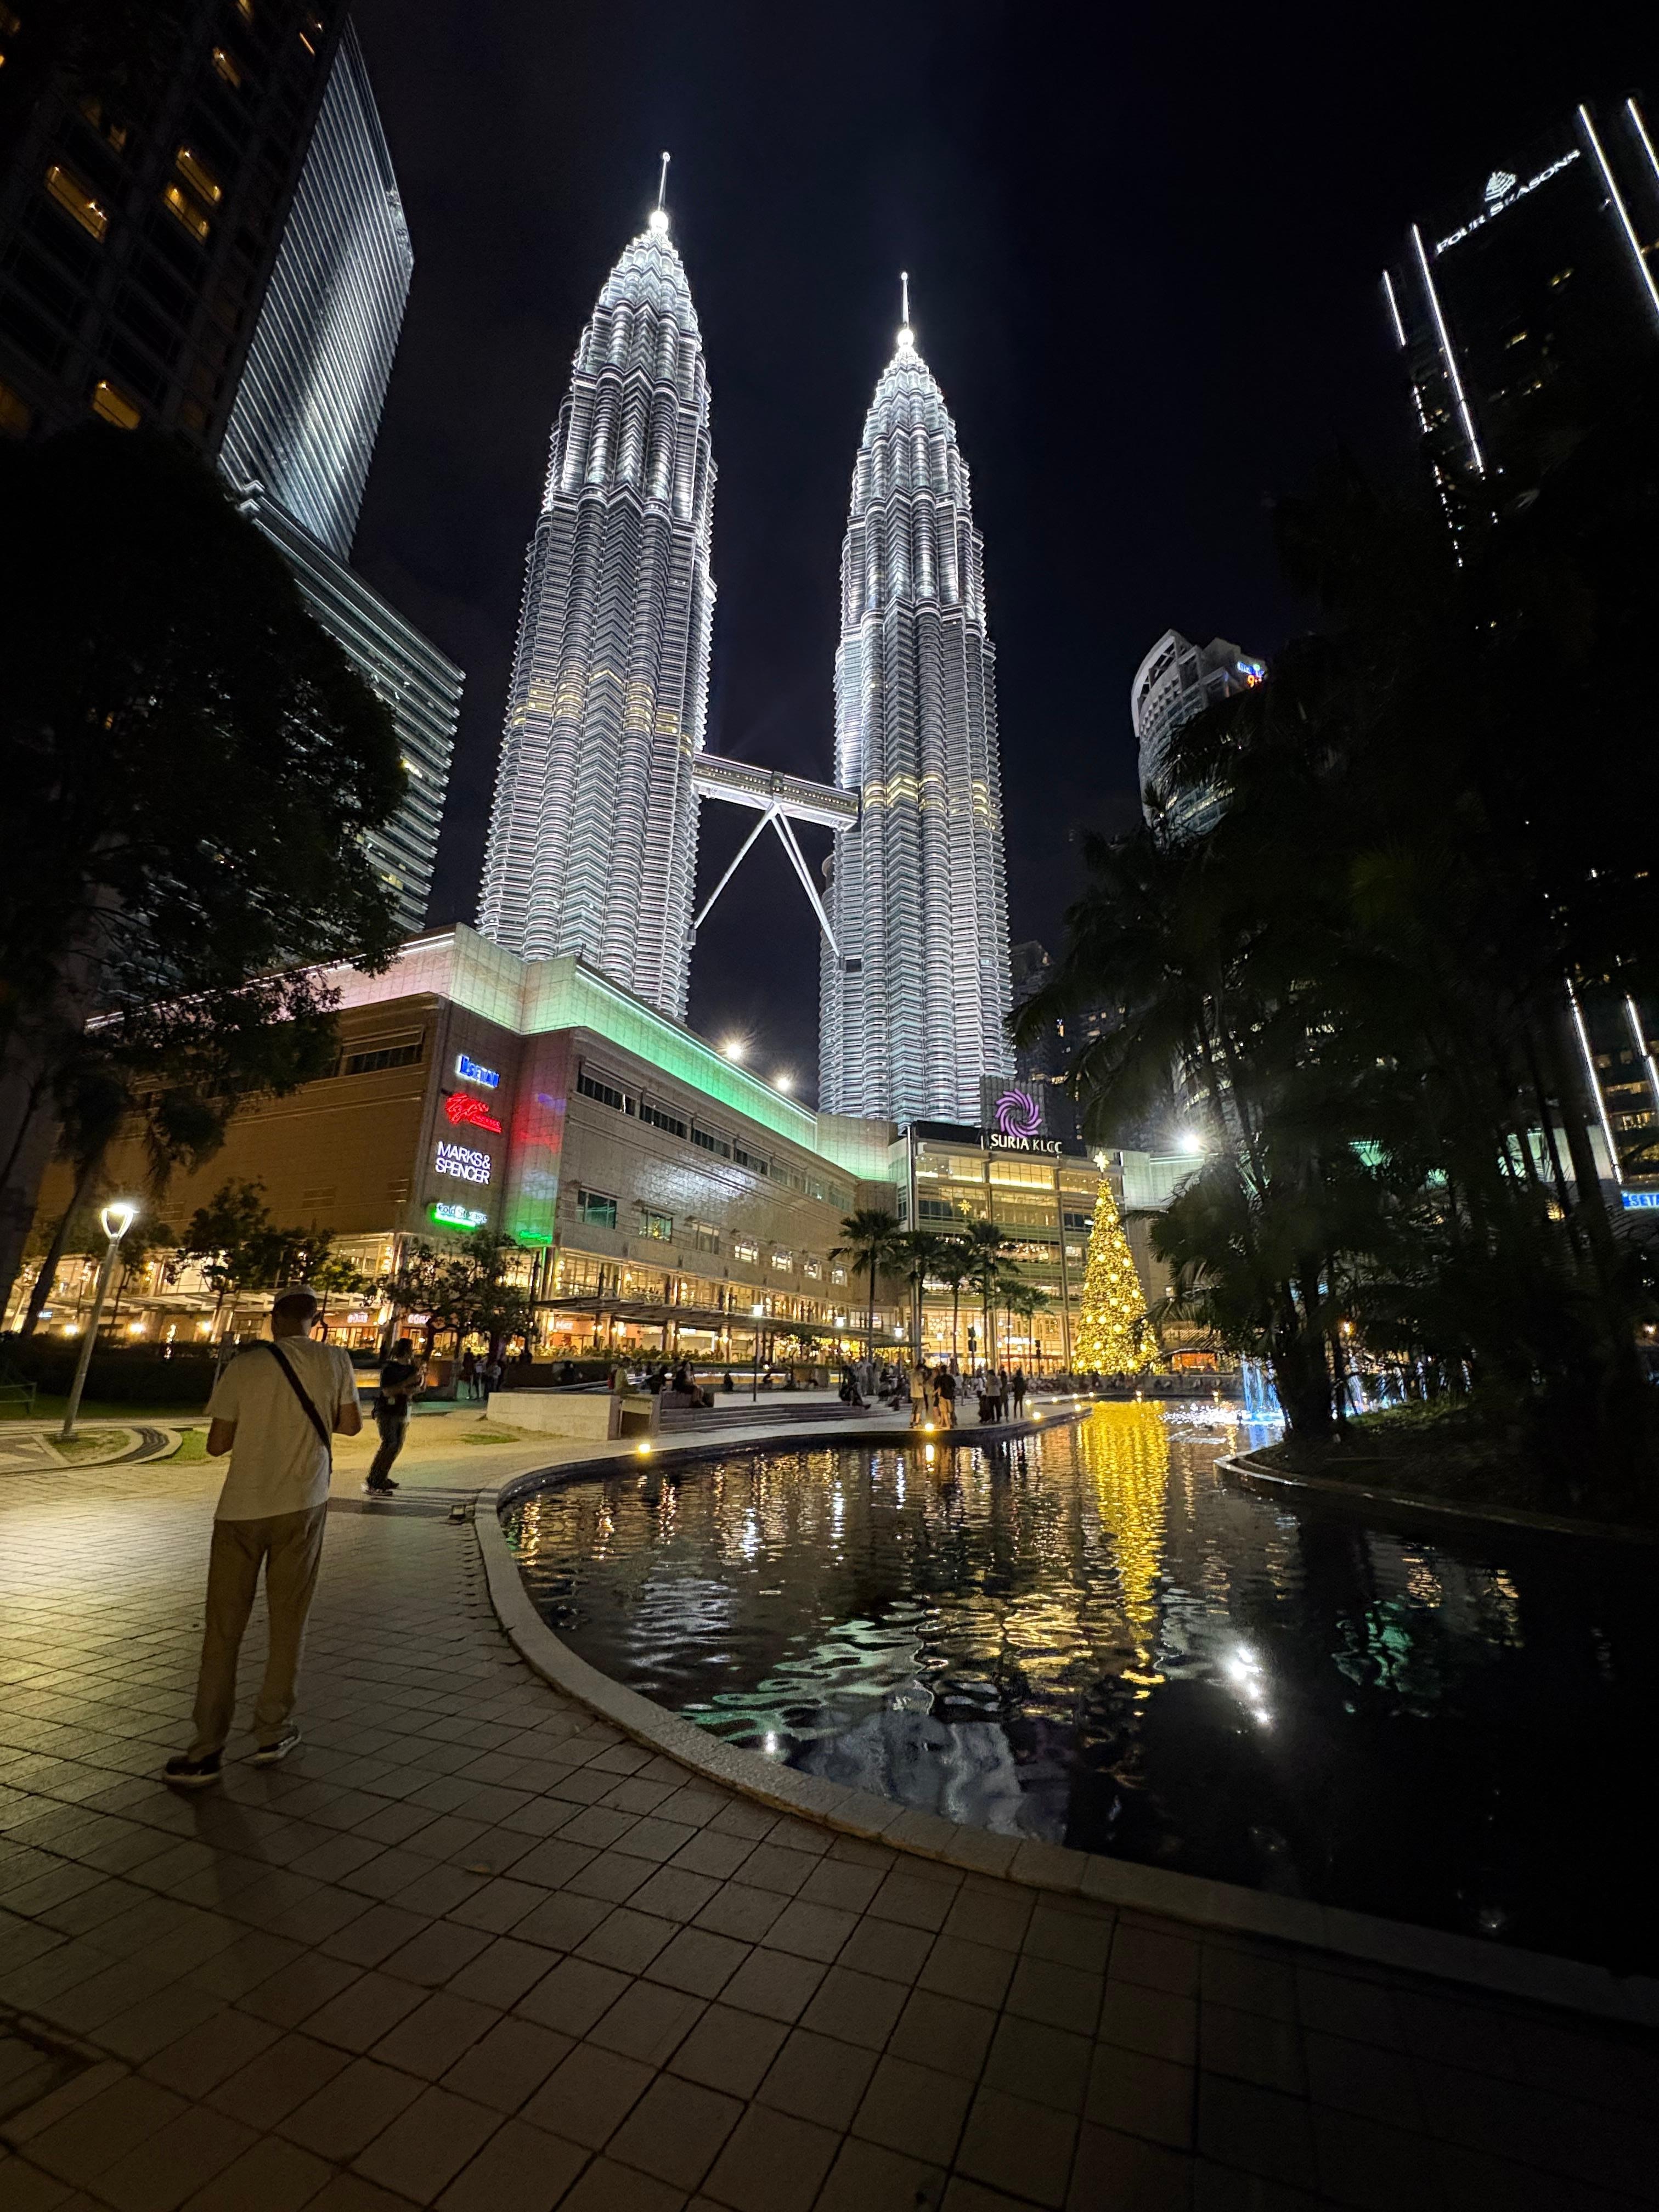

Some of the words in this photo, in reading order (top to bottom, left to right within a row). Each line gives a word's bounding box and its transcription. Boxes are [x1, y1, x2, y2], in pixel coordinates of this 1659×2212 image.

[1436, 215, 1486, 253] FOUR
[990, 1133, 1029, 1150] SURIA
[1033, 1139, 1062, 1154] KLCC
[436, 1158, 489, 1184] SPENCER
[438, 1204, 456, 1215] Cold
